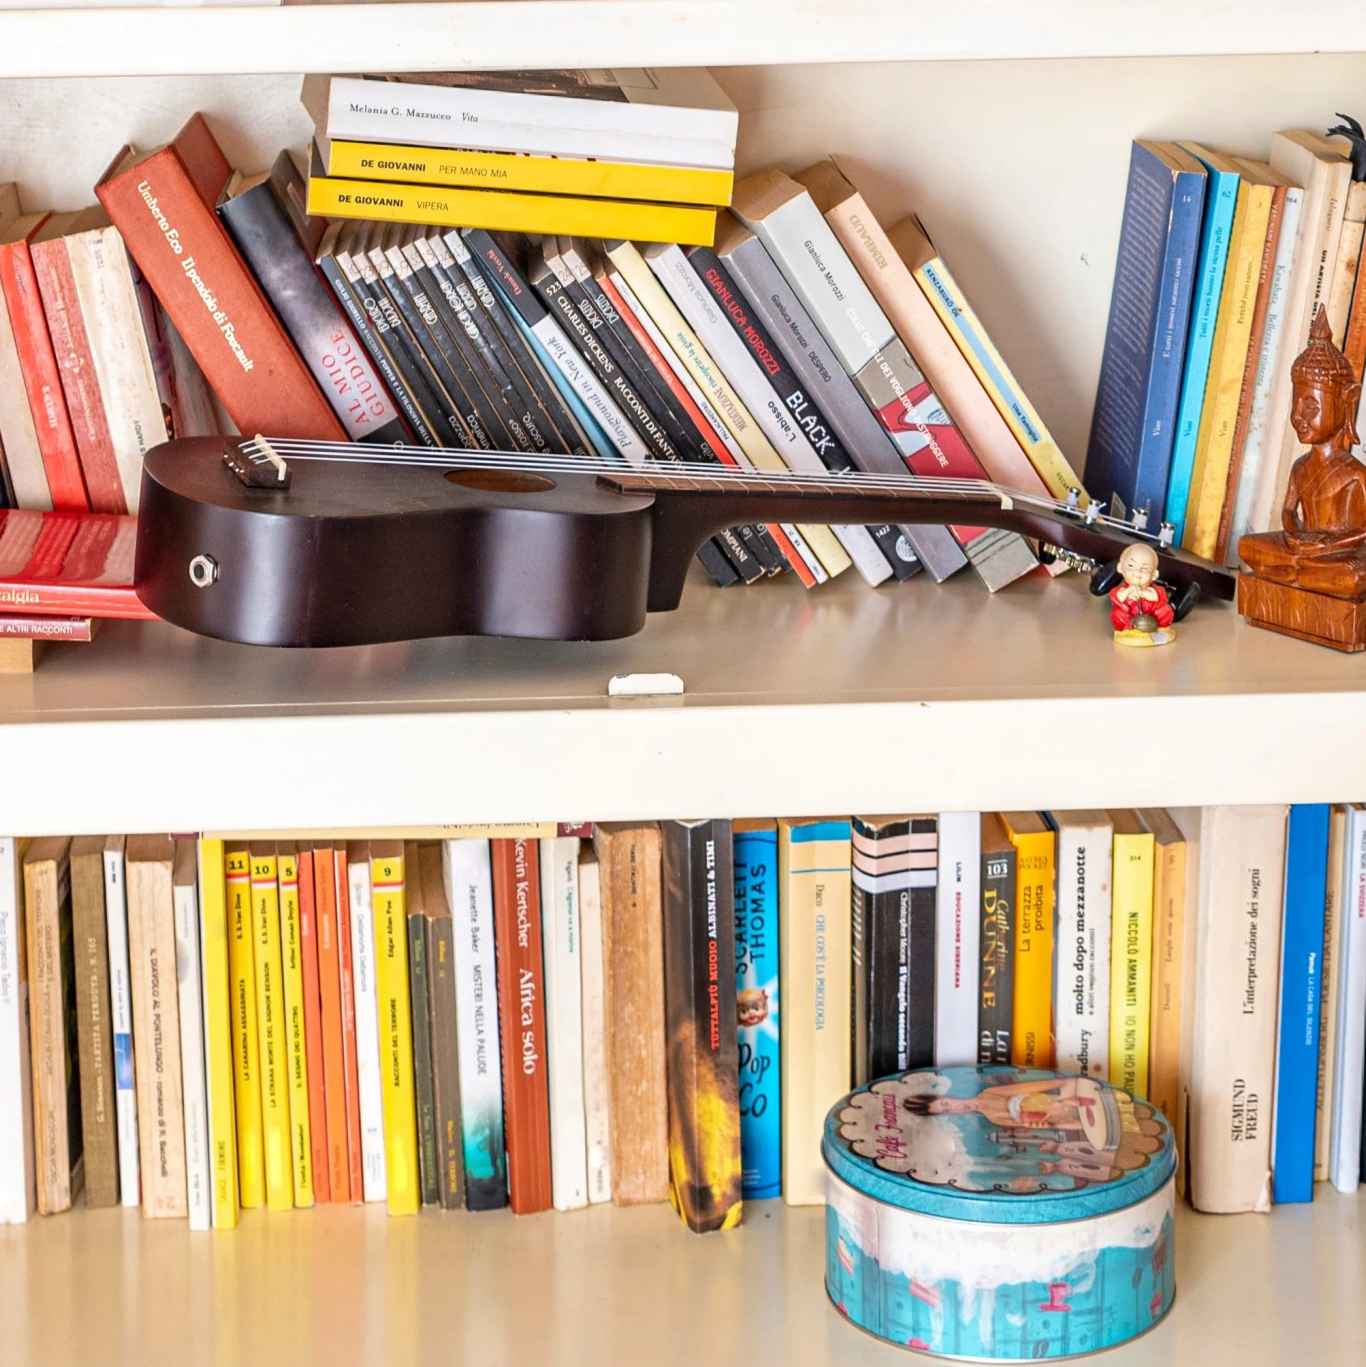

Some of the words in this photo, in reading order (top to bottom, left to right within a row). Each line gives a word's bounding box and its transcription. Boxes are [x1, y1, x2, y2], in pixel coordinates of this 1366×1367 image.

[350, 104, 387, 115] Melania
[391, 107, 401, 116] G.
[406, 109, 451, 121] Mazzucco
[461, 112, 479, 123] Vita
[361, 159, 373, 168] DE
[377, 160, 426, 172] GIOVANNI
[439, 165, 456, 175] PER
[459, 167, 486, 177] MANO
[490, 169, 508, 179] MIA
[137, 179, 169, 229] Umberto
[338, 194, 351, 203] DE
[354, 195, 403, 208] GIOVANNI
[416, 200, 449, 212] VIPERA
[164, 227, 183, 255] Eco
[182, 256, 194, 271] Il
[186, 267, 218, 313] pendolo
[214, 309, 227, 325] di
[706, 268, 746, 326] GIANLUCA
[743, 323, 780, 376] MOROZZI
[220, 321, 255, 373] Foucault
[785, 390, 835, 457] BLACK
[229, 859, 245, 871] 11
[254, 864, 270, 876] 10
[383, 866, 391, 877] 9
[705, 838, 716, 867] TIMI
[987, 862, 1008, 877] 103
[706, 868, 716, 880] &
[1073, 846, 1087, 932] mezzanotte
[1249, 868, 1260, 898] sogni
[516, 881, 529, 948] Kertscher
[706, 880, 718, 939] ALBINATI
[749, 862, 767, 964] THOMAS
[1248, 901, 1259, 918] dei
[708, 941, 718, 983] MUOIO
[982, 887, 998, 1009] DUNNE
[1073, 937, 1086, 972] dopo
[1242, 921, 1259, 1015] L'interpretazione
[519, 968, 533, 1025] Africa
[1073, 974, 1084, 1015] molto
[708, 985, 720, 1050] TUTTALPIÙ
[521, 1032, 535, 1075] solo
[739, 1081, 766, 1119] Co
[1232, 1077, 1246, 1143] SIGMUND
[1244, 1092, 1258, 1140] FREUD
